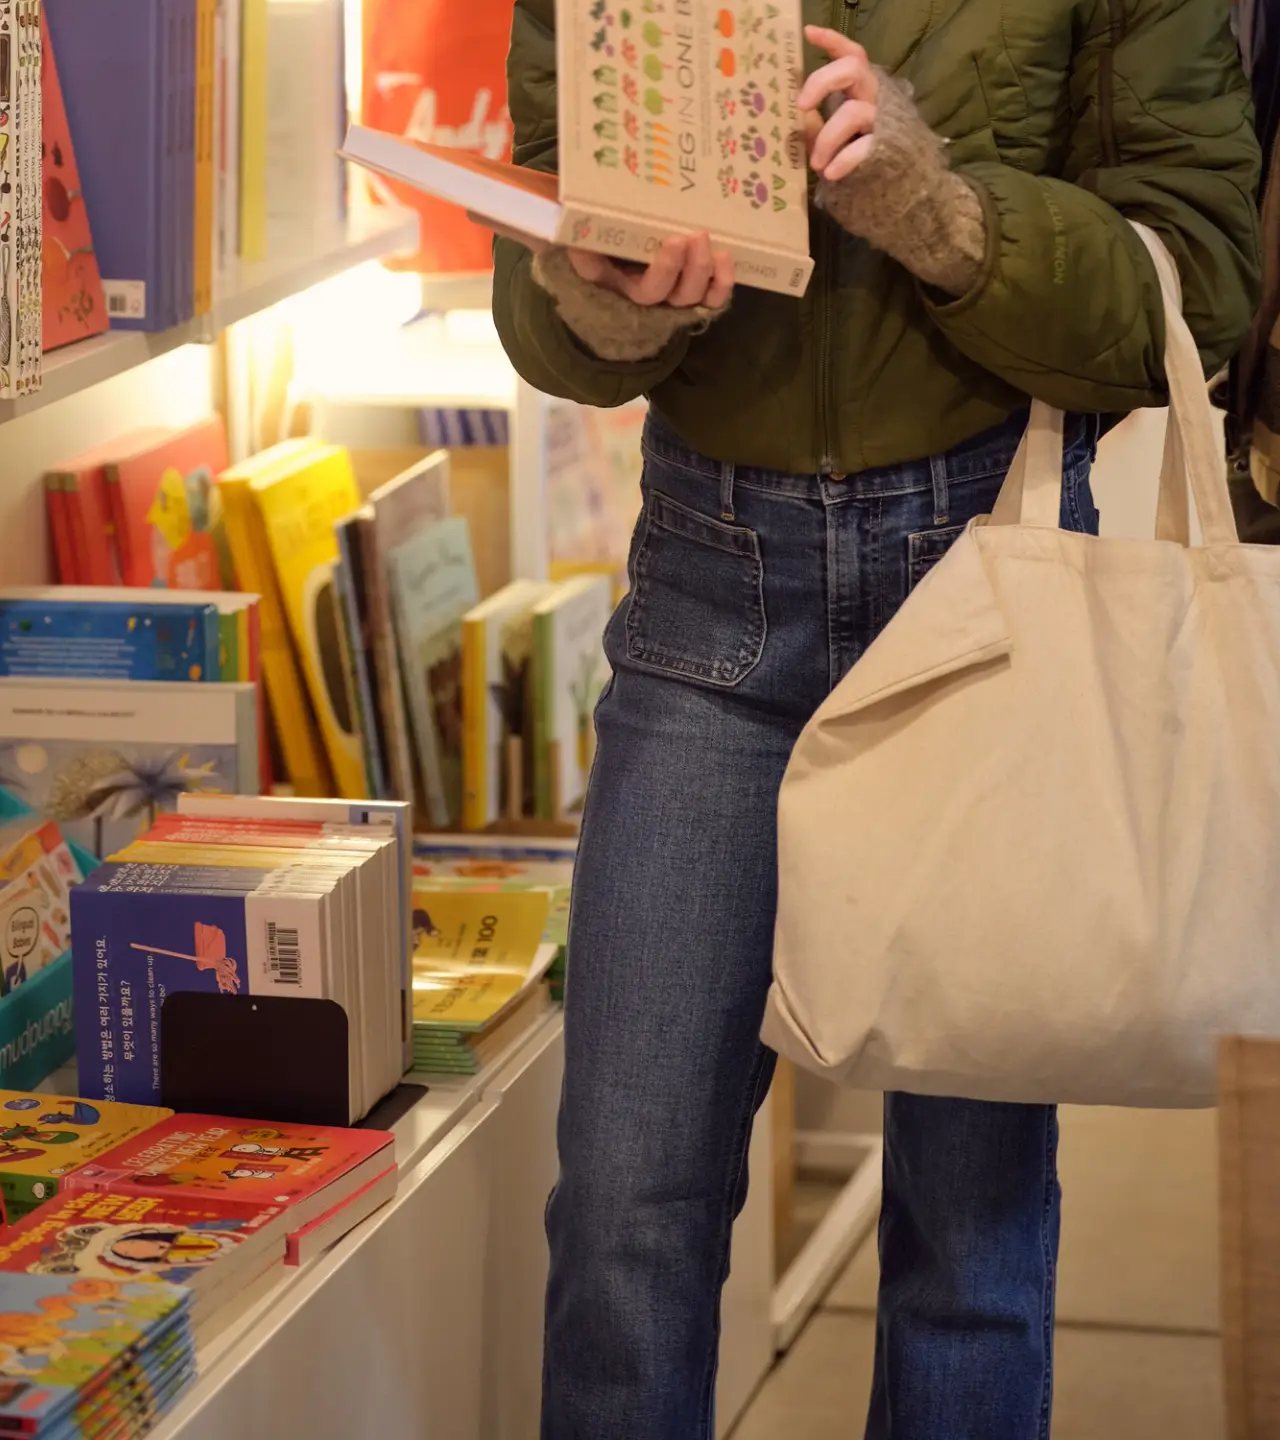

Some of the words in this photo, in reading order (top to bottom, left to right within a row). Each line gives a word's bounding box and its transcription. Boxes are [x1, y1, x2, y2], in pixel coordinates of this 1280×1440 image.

[676, 30, 695, 90] ONE
[784, 30, 799, 123] RICHARDS
[677, 96, 696, 125] IN
[677, 131, 697, 193] VEG
[97, 972, 109, 1003] 가지가
[147, 967, 155, 988] clean
[148, 989, 155, 998] to
[148, 999, 157, 1019] ways
[150, 1021, 158, 1042] many
[151, 1044, 158, 1053] so
[151, 1054, 159, 1067] are
[151, 1068, 160, 1090] There
